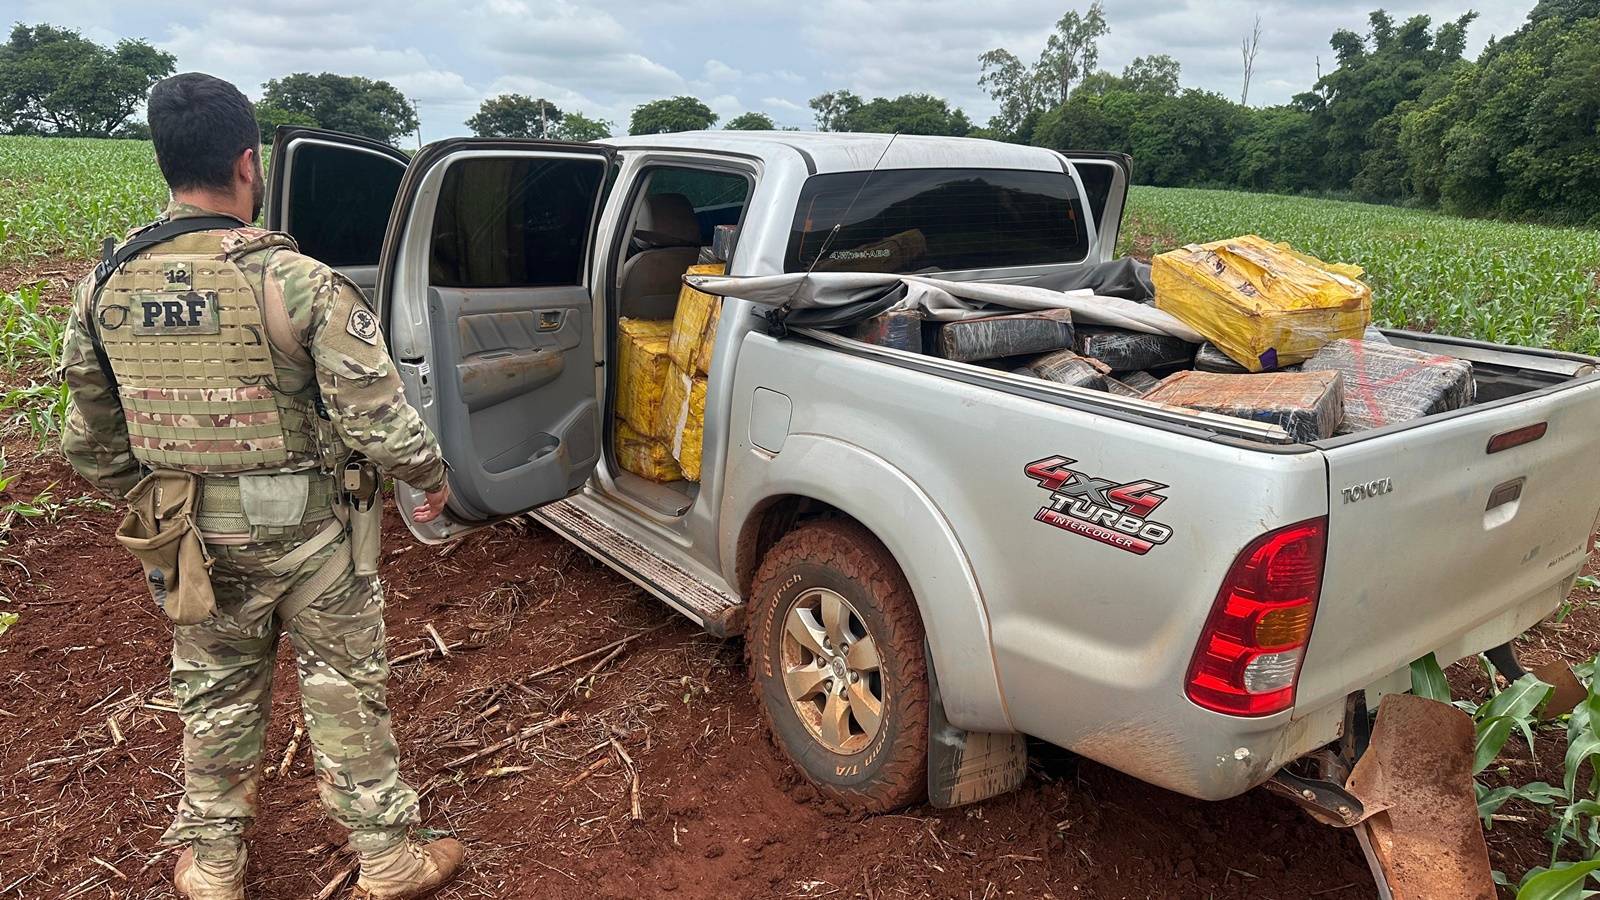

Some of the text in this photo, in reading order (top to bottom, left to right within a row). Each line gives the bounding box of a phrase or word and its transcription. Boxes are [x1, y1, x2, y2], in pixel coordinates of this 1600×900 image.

[166, 269, 187, 284] 12
[141, 301, 206, 327] PRF
[1341, 477, 1393, 504] TOYOTA
[1051, 491, 1173, 545] TURBO
[1052, 512, 1134, 548] INTERCOOLER
[763, 573, 802, 678] BFGoodrich
[835, 764, 859, 777] T/A
